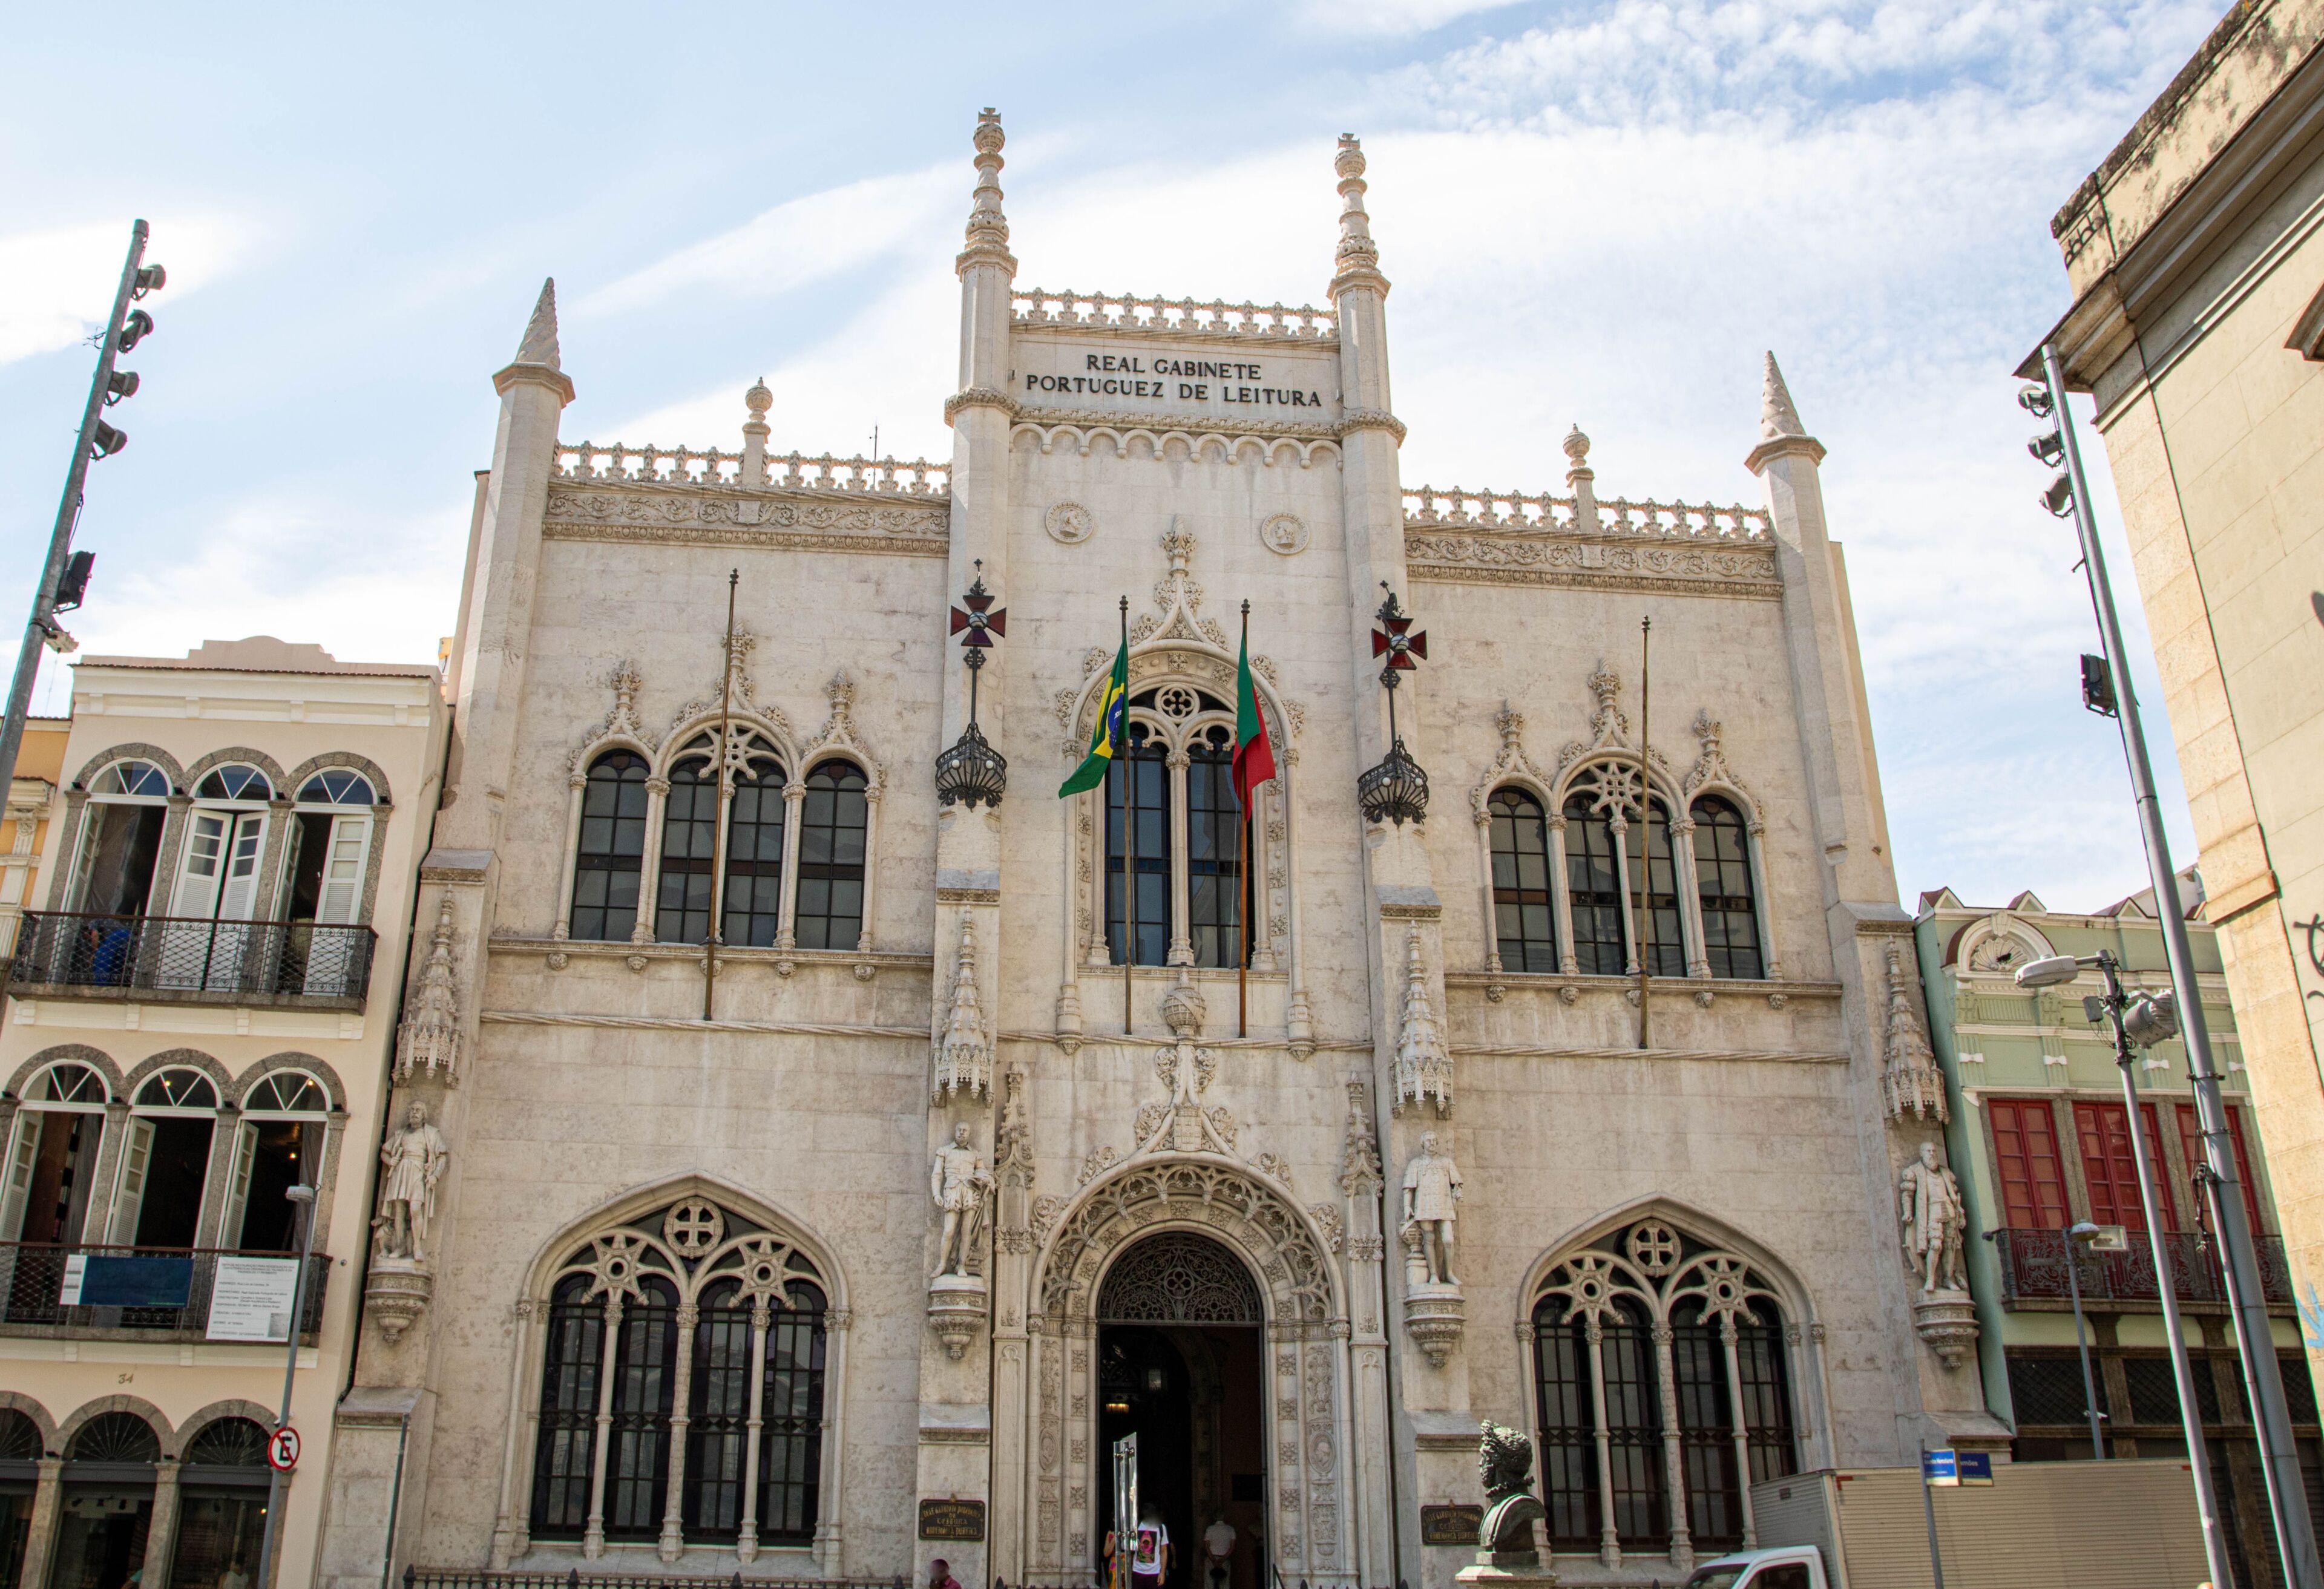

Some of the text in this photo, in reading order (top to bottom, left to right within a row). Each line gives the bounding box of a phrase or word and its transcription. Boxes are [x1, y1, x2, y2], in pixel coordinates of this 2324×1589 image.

[1086, 355, 1261, 379] REAL GABINETE
[1026, 375, 1321, 407] PORTUGUEZ DE LEITURA
[118, 1374, 134, 1384] 34
